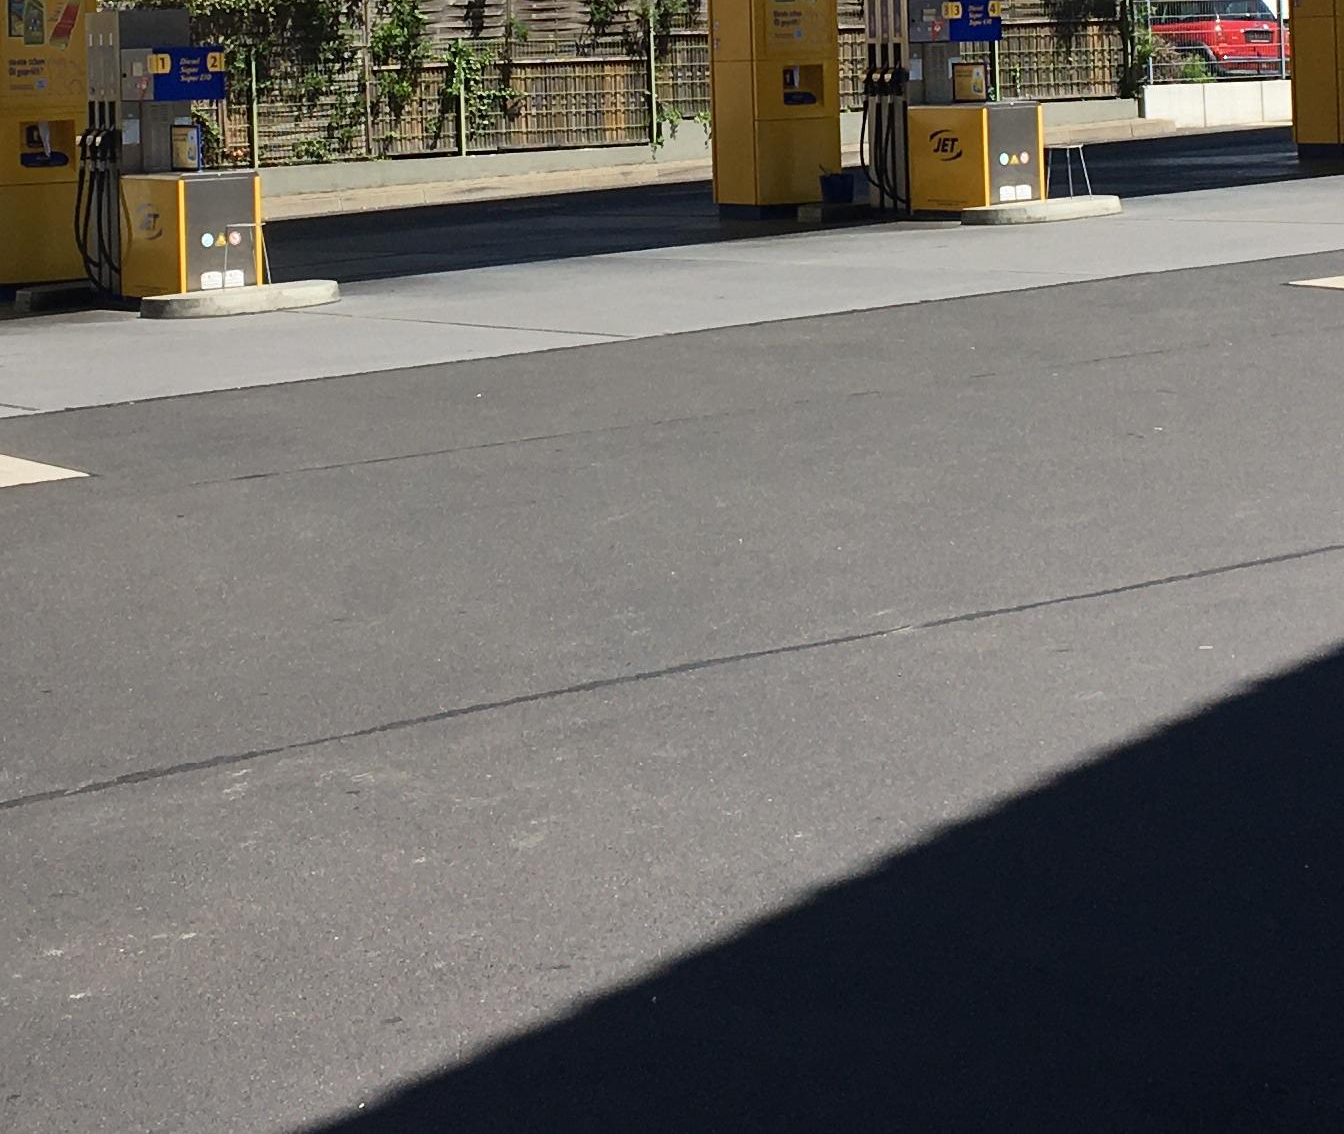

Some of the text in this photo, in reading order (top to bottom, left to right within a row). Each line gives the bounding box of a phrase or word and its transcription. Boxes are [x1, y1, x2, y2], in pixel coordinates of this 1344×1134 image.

[955, 4, 960, 16] 3
[989, 2, 996, 14] 4
[159, 57, 165, 70] 1
[210, 56, 218, 68] 2
[932, 137, 959, 154] JET
